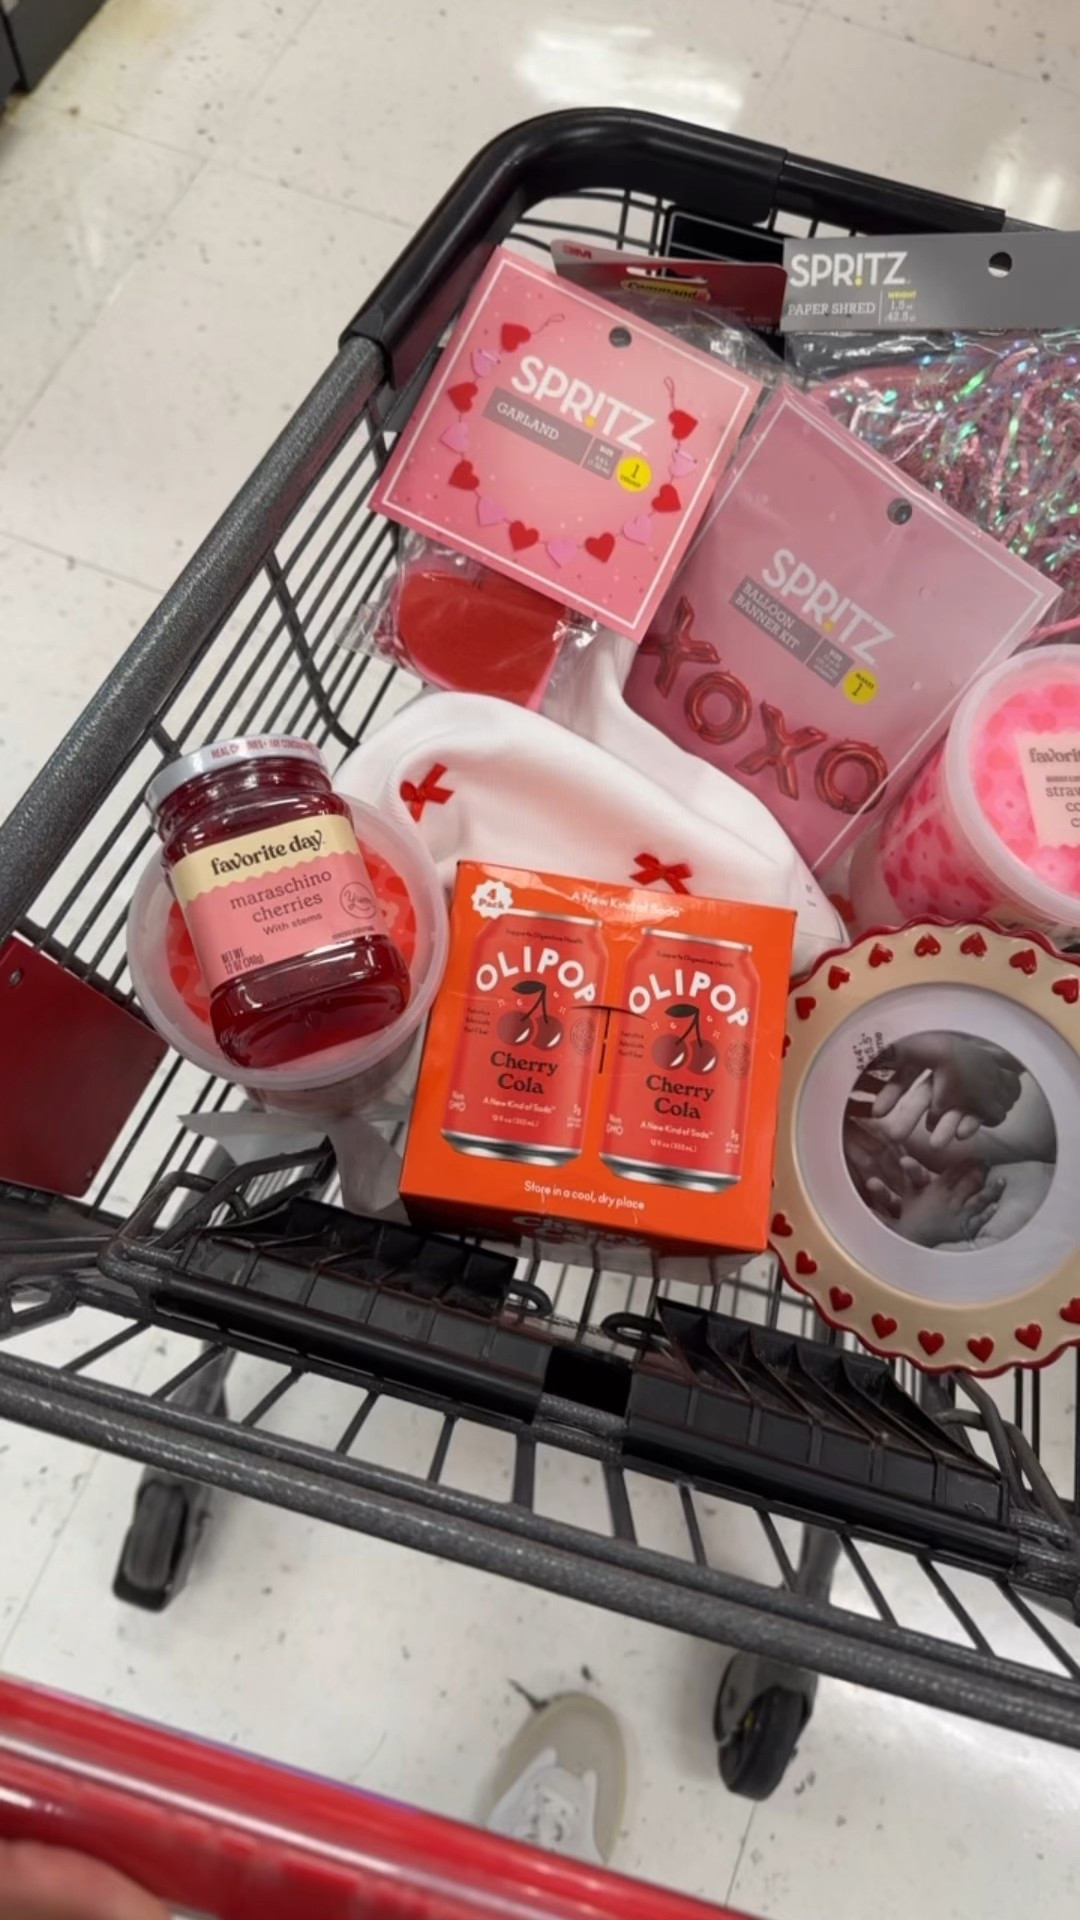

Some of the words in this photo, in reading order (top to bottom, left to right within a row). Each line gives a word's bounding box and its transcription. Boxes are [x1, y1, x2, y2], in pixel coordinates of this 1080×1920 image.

[788, 303, 829, 316] PAPER
[831, 302, 876, 315] SHRED
[496, 402, 560, 441] GARLAND
[631, 463, 640, 480] 1
[741, 582, 796, 630] BALLOON
[734, 593, 780, 637] BANNER
[779, 631, 801, 651] KIT
[210, 844, 288, 876] favorite
[289, 829, 324, 852] day
[230, 870, 333, 910] maraschino
[487, 887, 497, 900] 4
[252, 892, 324, 923] cherries
[477, 898, 505, 910] Pack
[262, 921, 290, 936] With
[292, 912, 323, 928] stems
[476, 945, 596, 1003] OLIPOP
[628, 968, 749, 1027] OLIPOP
[490, 1050, 559, 1077] Cherry
[497, 1073, 545, 1095] Cola
[646, 1074, 715, 1102] Cherry
[482, 1096, 490, 1105] A
[653, 1097, 702, 1120] Cola
[640, 1121, 648, 1129] A
[524, 1180, 551, 1195] Store
[552, 1185, 562, 1197] in
[563, 1189, 571, 1198] a
[571, 1190, 597, 1203] cool,
[597, 1193, 616, 1208] dry
[616, 1196, 645, 1211] place
